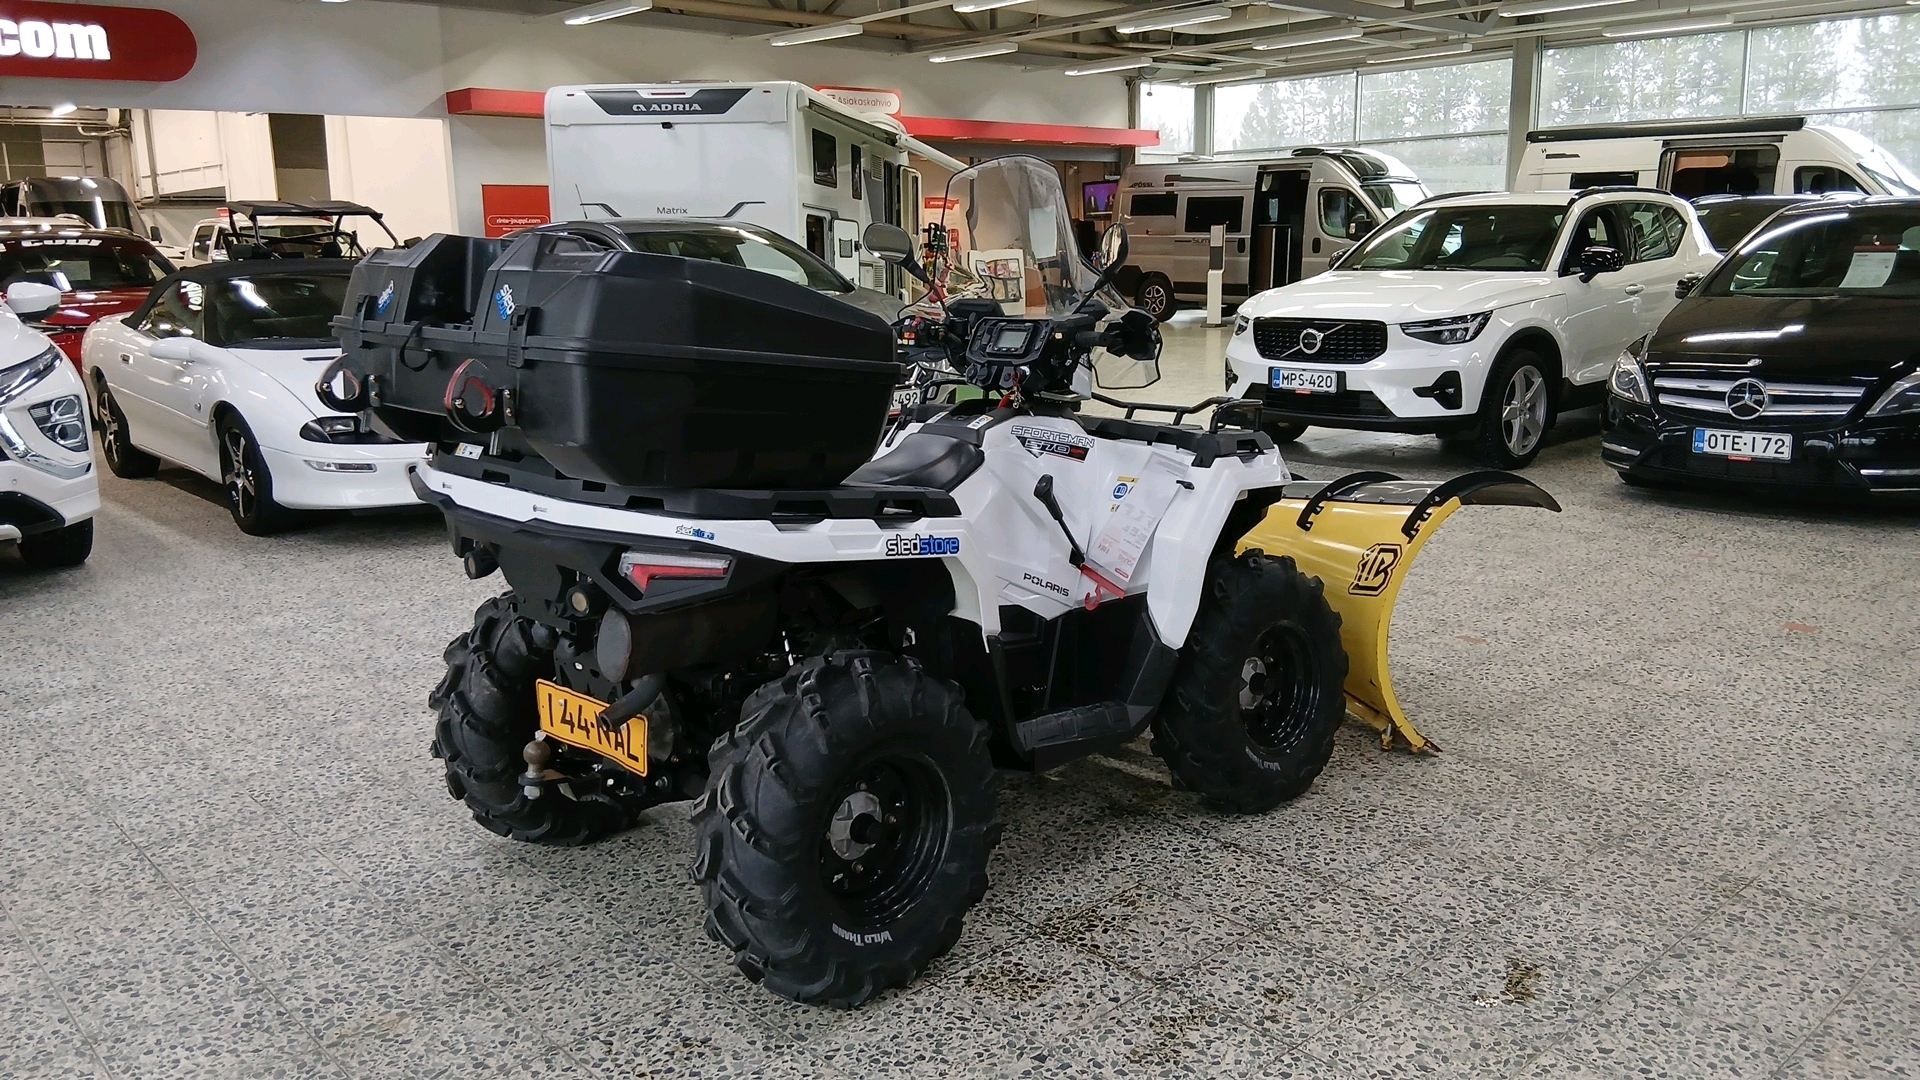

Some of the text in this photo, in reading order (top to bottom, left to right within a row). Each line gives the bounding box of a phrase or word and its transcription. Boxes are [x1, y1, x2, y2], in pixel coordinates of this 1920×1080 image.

[649, 103, 702, 111] ADRIA
[838, 96, 892, 107] Asiakaskahvio
[656, 206, 688, 215] Matrix
[1281, 372, 1333, 389] MPS-420
[1011, 425, 1096, 449] SPORTSMAN
[1707, 433, 1786, 455] OTE-172
[1025, 438, 1071, 455] 570
[1023, 572, 1070, 598] POLARIS
